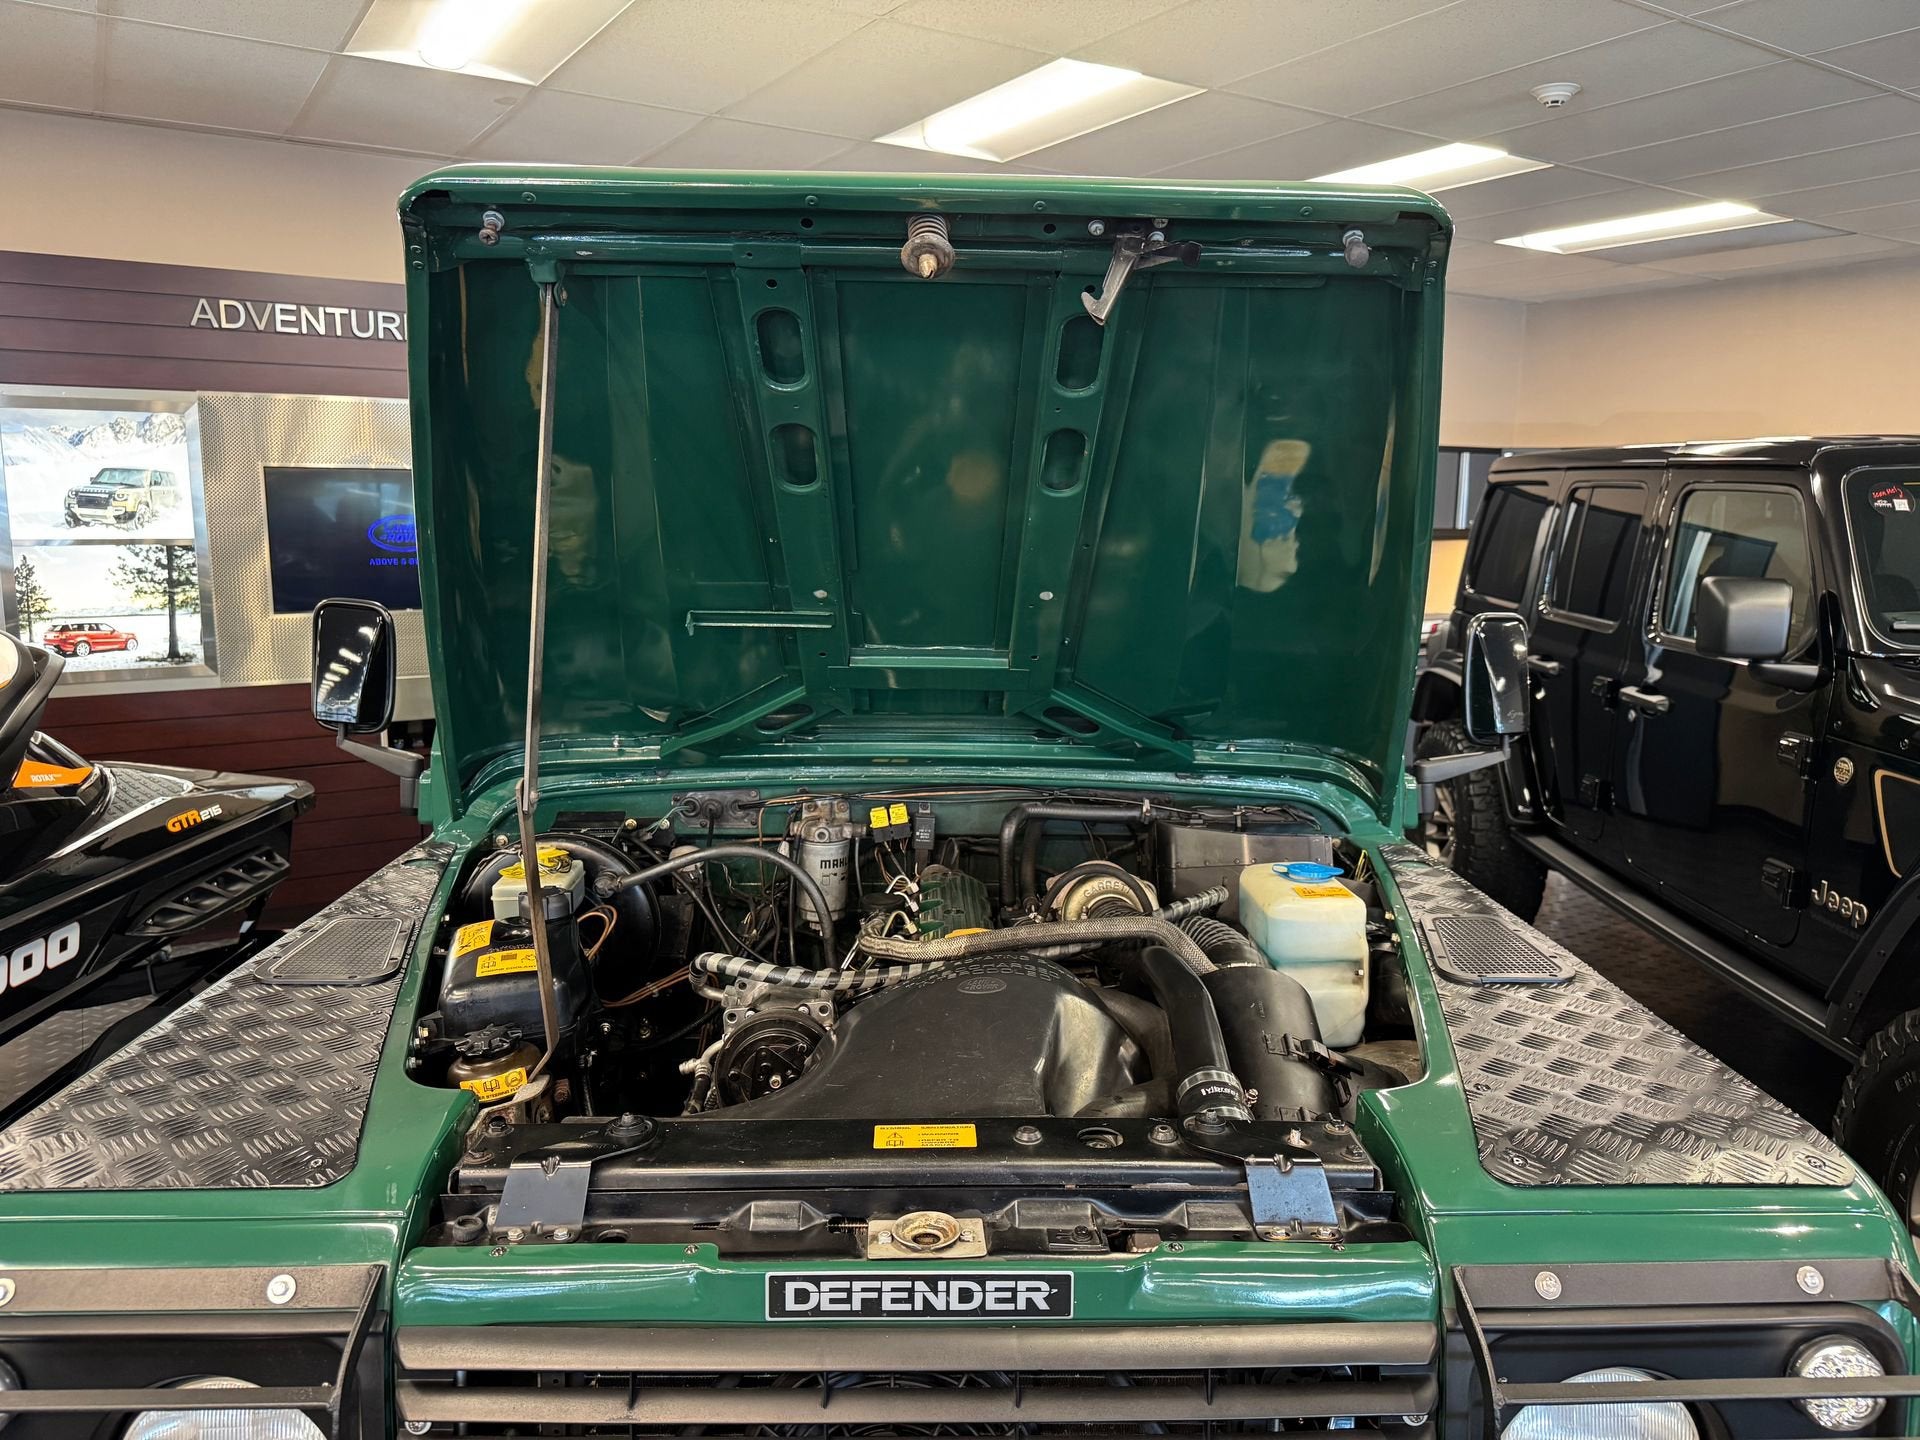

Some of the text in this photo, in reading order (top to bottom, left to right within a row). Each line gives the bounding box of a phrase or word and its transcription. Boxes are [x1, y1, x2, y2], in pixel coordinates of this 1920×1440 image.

[190, 297, 408, 341] ADVENTUR
[30, 773, 56, 783] ROTAX
[1811, 879, 1868, 929] Jeep
[785, 1280, 1052, 1311] DEFENDER
